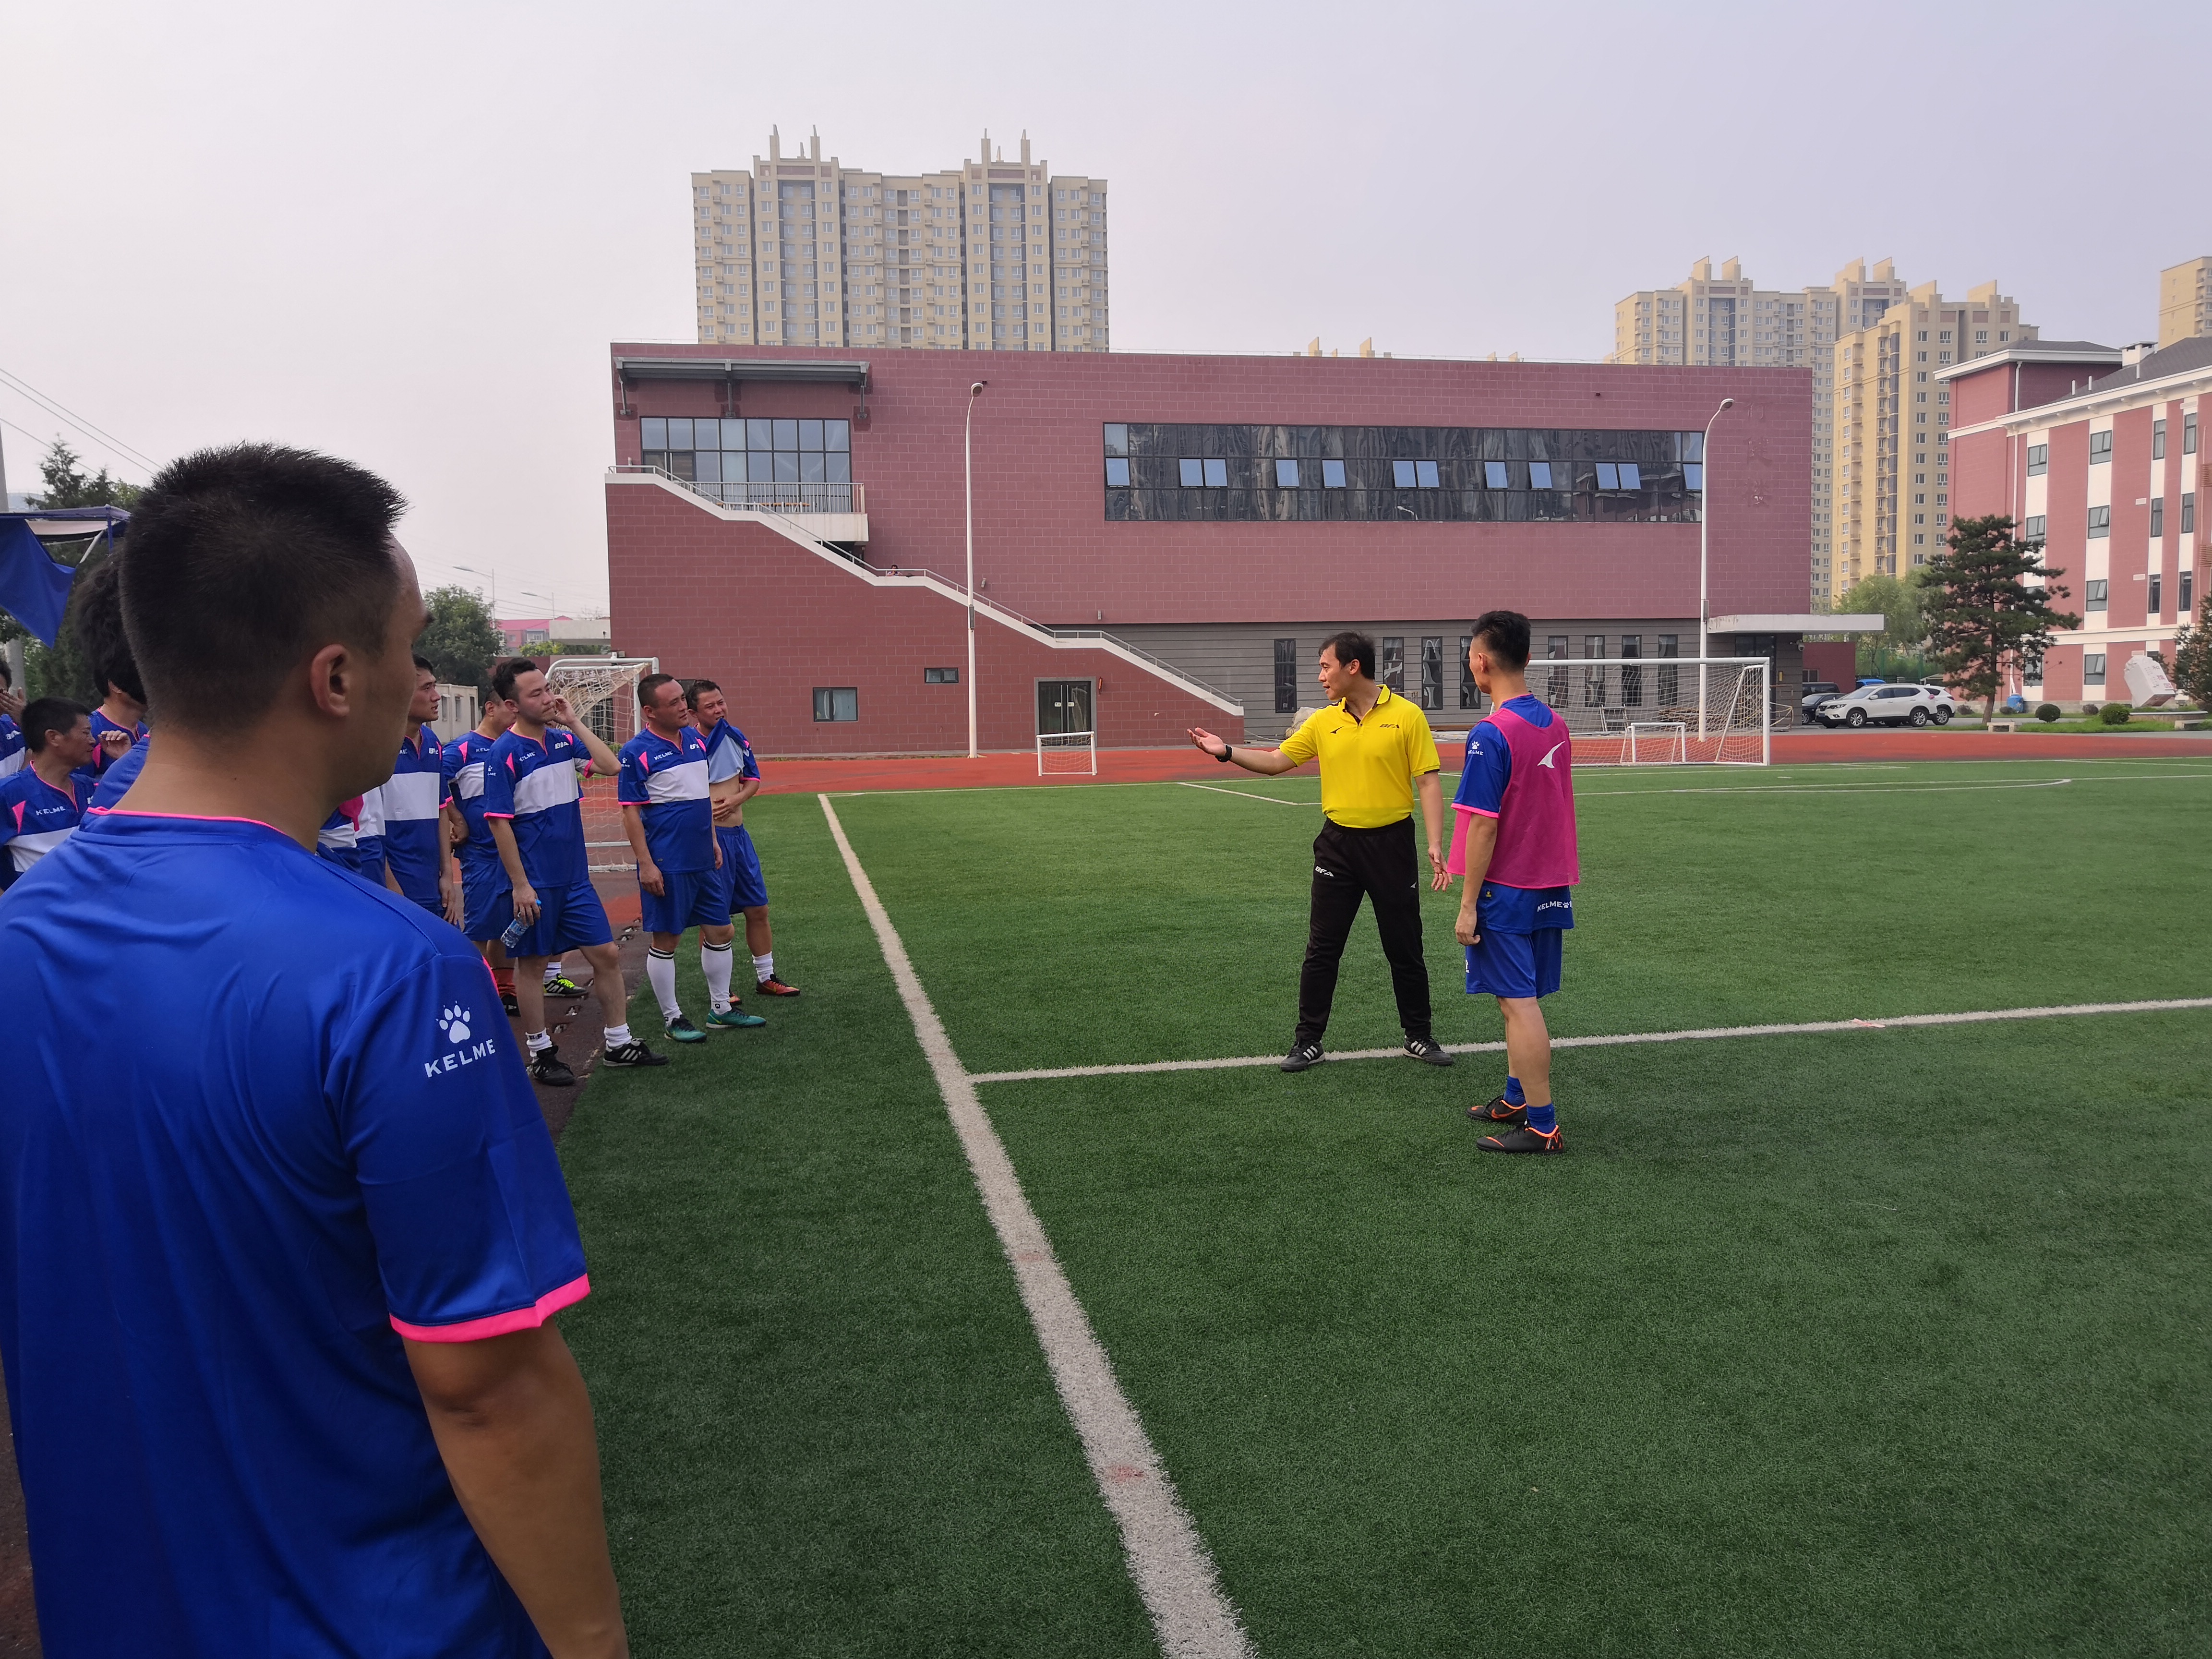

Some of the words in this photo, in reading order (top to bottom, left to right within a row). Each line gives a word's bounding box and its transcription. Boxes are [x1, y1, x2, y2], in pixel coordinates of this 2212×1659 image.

[36, 806, 66, 816] KELME
[1315, 866, 1334, 877] BFA
[1537, 901, 1563, 912] KELME
[424, 1039, 496, 1078] KELME
